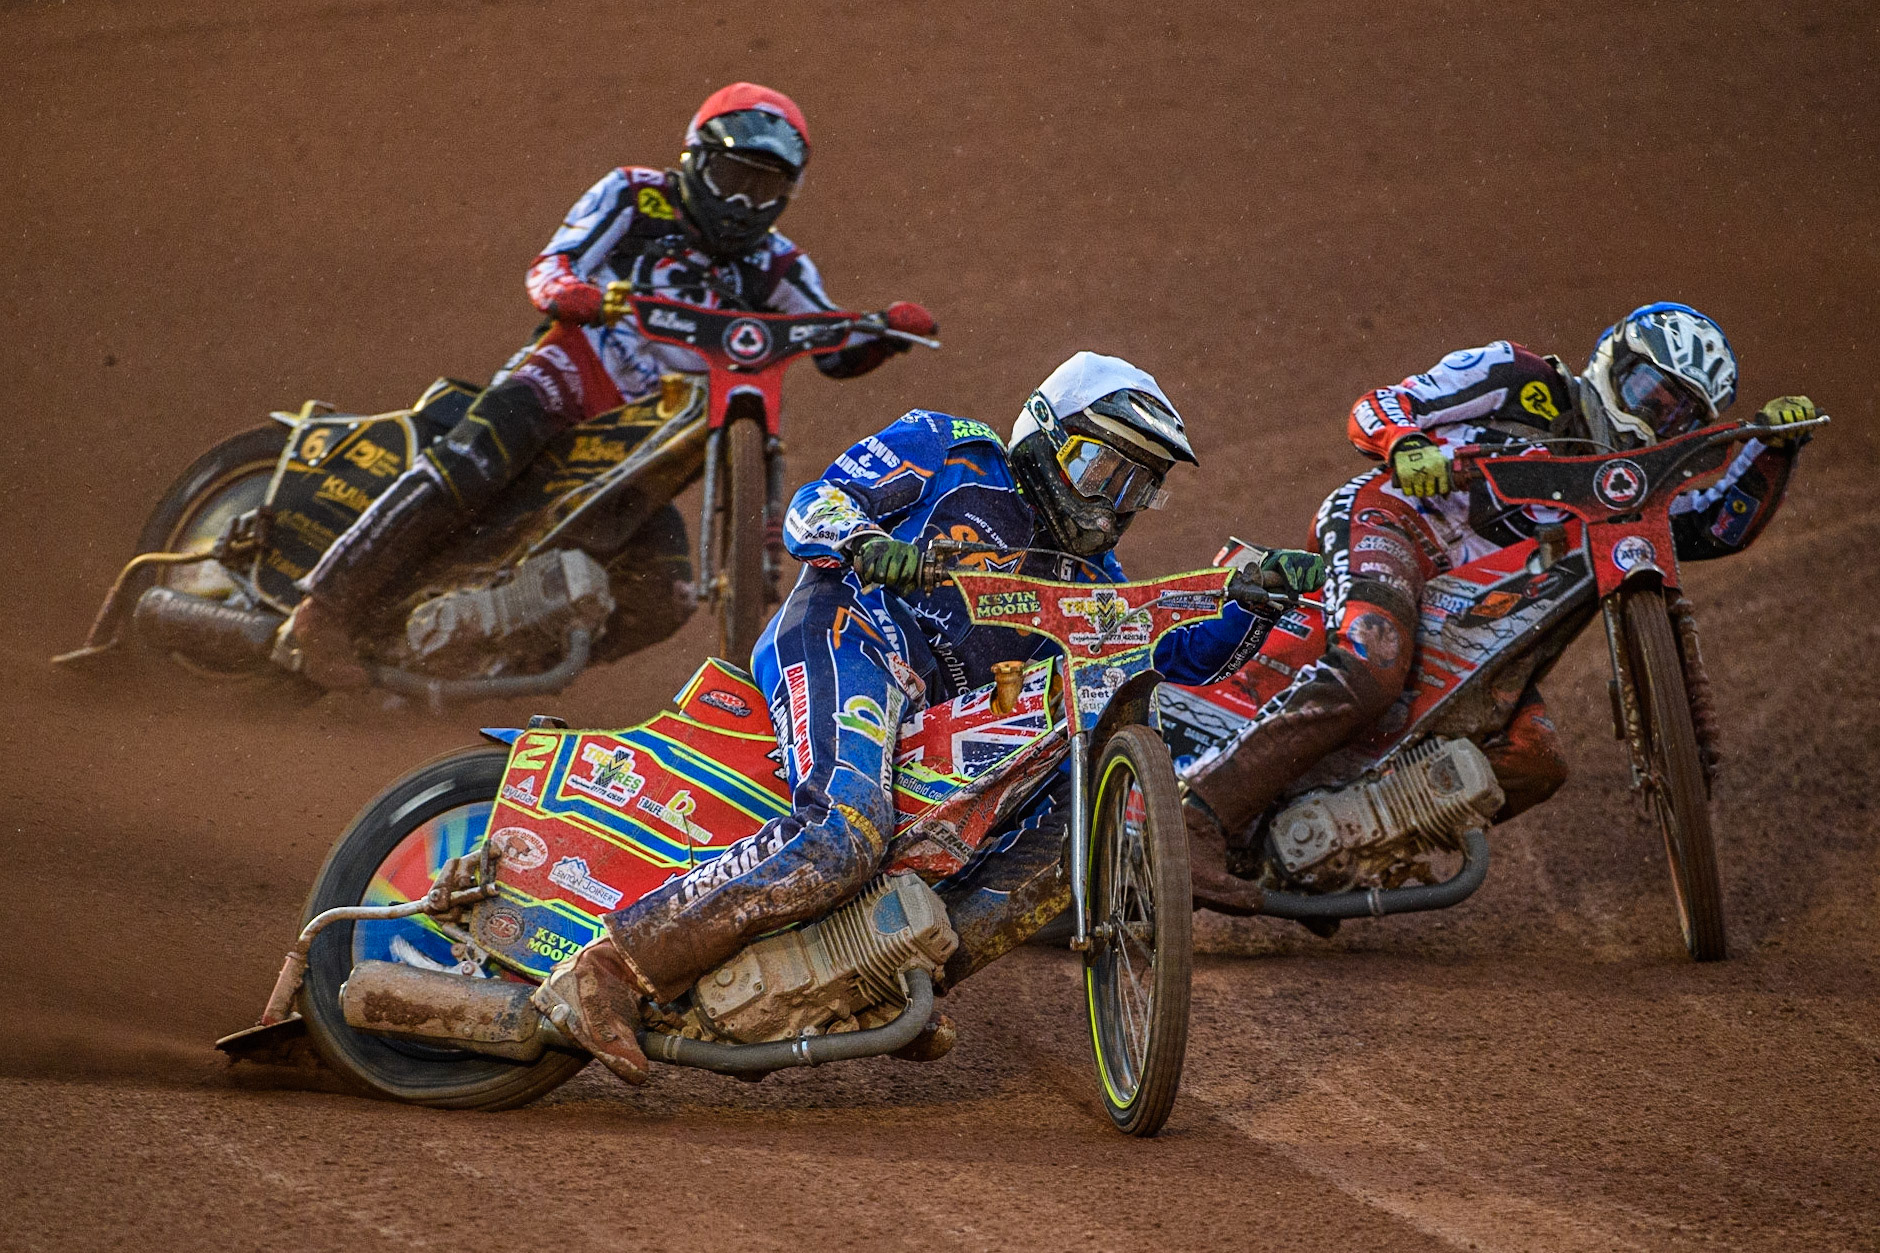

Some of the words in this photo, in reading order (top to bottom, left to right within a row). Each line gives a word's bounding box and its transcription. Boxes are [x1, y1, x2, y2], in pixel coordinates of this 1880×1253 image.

[301, 428, 331, 460] 6
[976, 602, 1041, 617] MOORE
[978, 591, 1037, 606] KEVIN
[872, 609, 901, 660] KIN
[1082, 689, 1110, 698] fleet
[511, 735, 558, 770] 2
[503, 785, 538, 805] ayudar
[897, 772, 928, 796] heffield
[552, 868, 581, 885] LENTON
[582, 879, 618, 904] JOINERY
